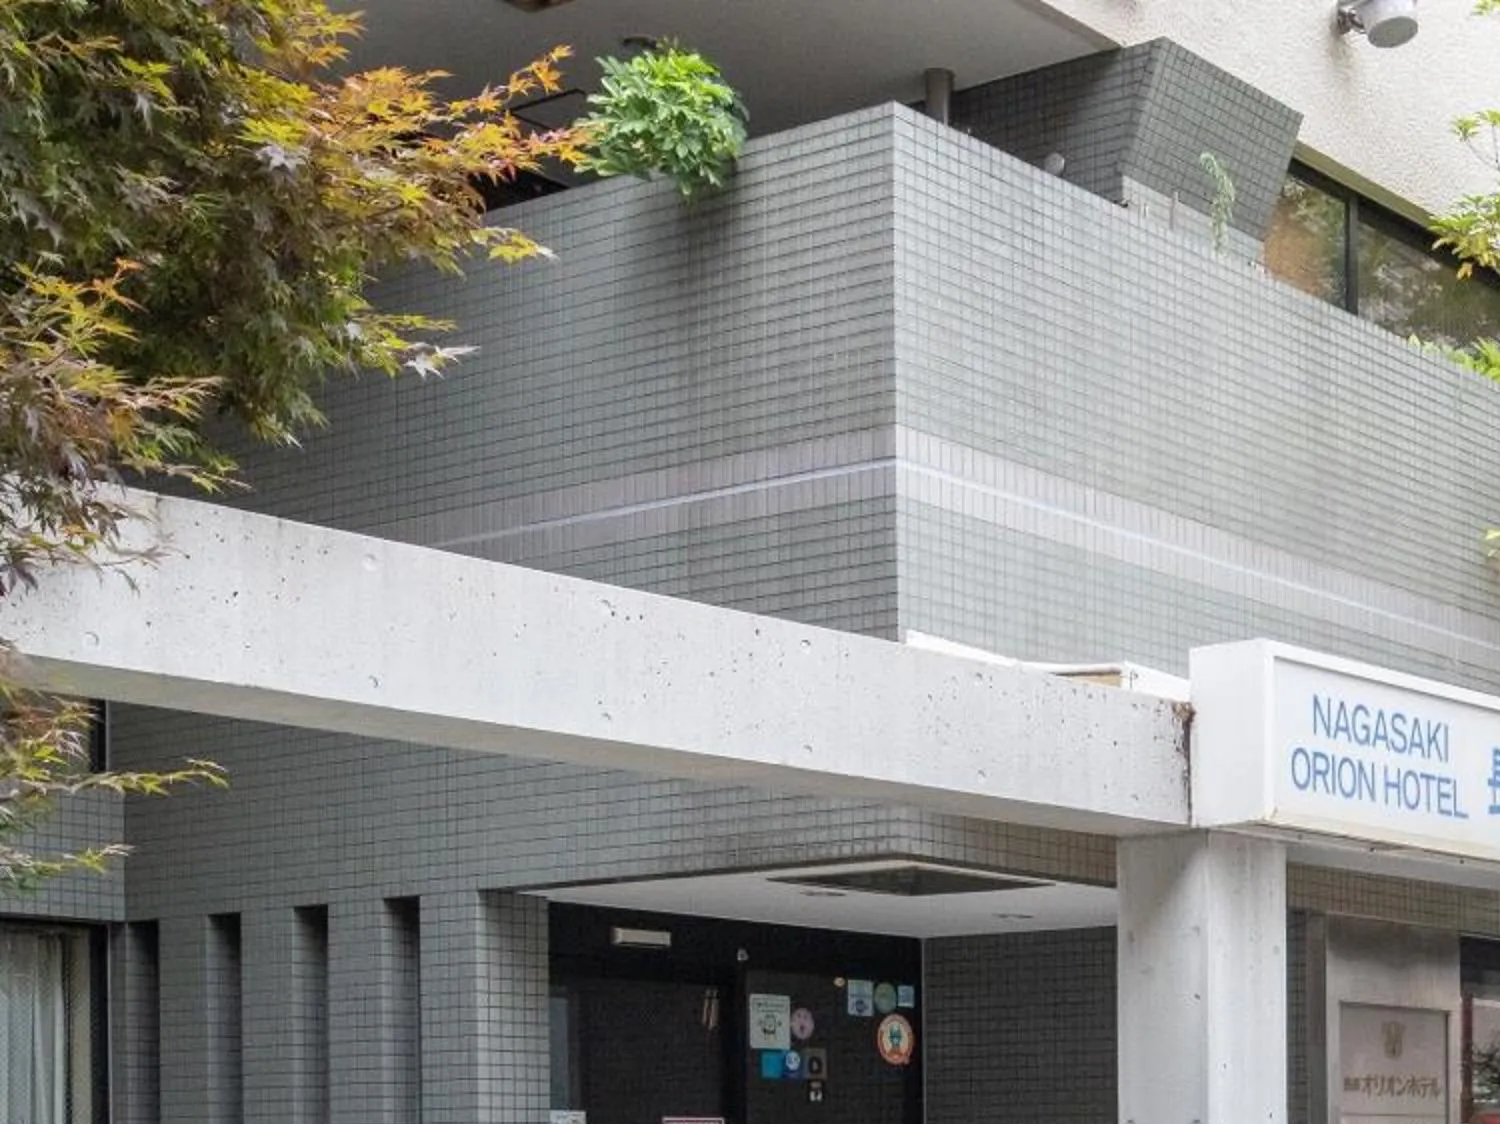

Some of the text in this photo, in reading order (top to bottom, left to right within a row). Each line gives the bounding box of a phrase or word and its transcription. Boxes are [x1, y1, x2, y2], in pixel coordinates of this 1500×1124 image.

[1312, 694, 1449, 763] NAGASAKI
[1291, 747, 1470, 820] ORION HOTEL
